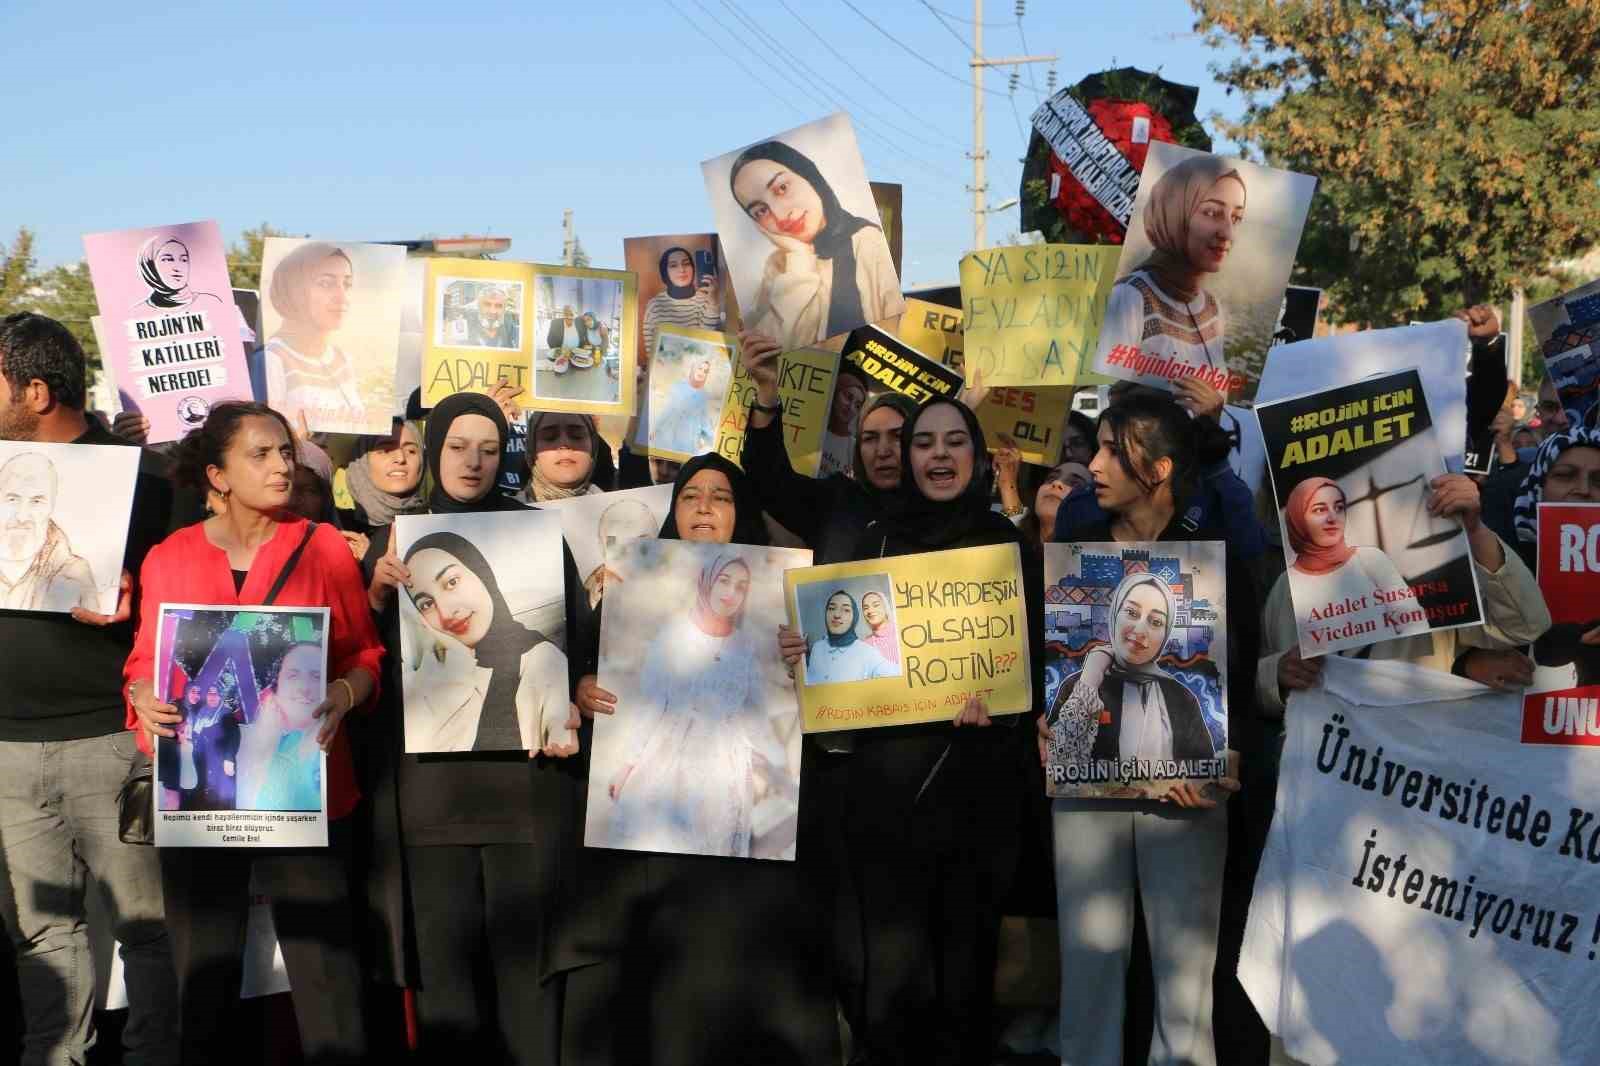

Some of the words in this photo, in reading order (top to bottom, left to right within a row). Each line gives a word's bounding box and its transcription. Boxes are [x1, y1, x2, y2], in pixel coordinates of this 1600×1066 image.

[972, 253, 1013, 287] YA
[136, 311, 205, 340] ROJİN'İN
[142, 335, 222, 367] KATİLLERİ
[977, 337, 1108, 380] OLSAY
[147, 368, 212, 394] NEREDE!
[428, 358, 529, 394] ADALET
[1290, 400, 1368, 433] #ROJİN
[1280, 412, 1415, 469] ADALET
[896, 581, 924, 608] YA
[926, 578, 1018, 608] KARDEŞİN
[1309, 596, 1367, 622] Adalet
[901, 614, 1016, 649] OLSAYDI
[1310, 617, 1377, 645] Vicdan
[1053, 758, 1109, 782] ROJİN
[1114, 756, 1150, 784] İÇİN
[1153, 759, 1227, 780] ADALET!
[1316, 713, 1551, 847] Üniversitede
[1352, 829, 1579, 953] İstemiyoruz
